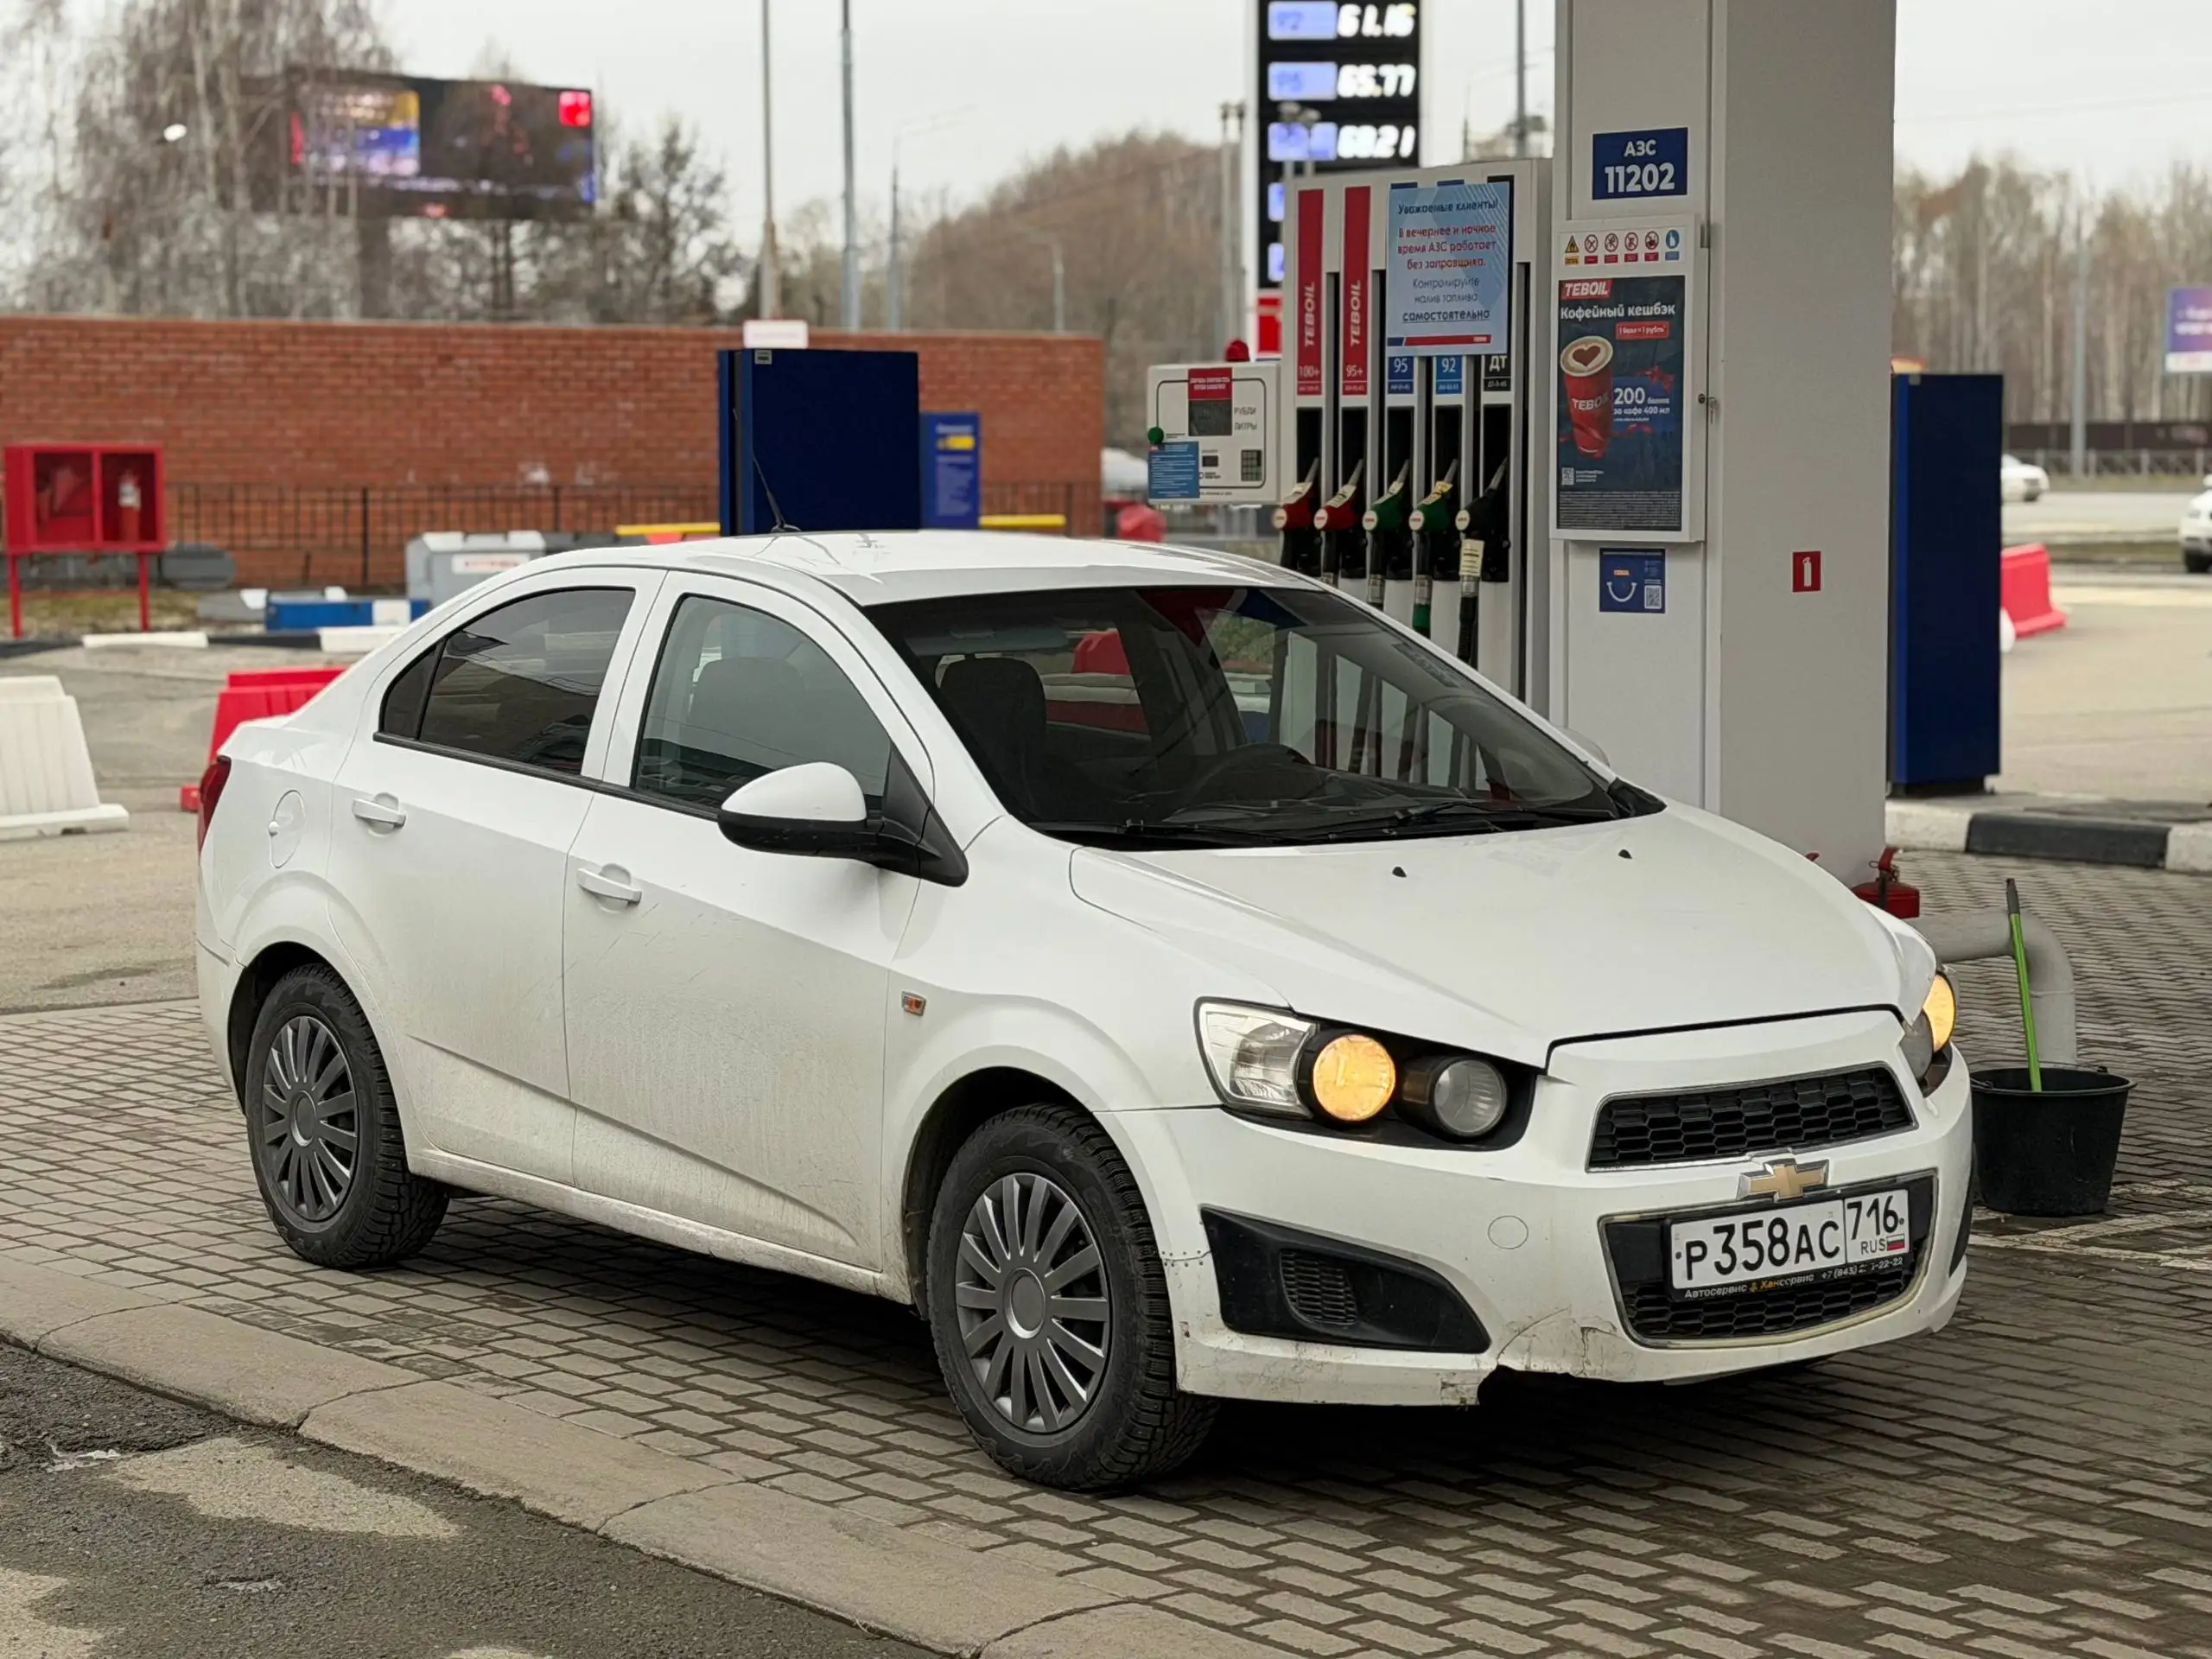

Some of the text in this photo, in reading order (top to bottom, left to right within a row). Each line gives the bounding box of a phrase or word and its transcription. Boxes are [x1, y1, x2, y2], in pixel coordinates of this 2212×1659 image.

[1624, 139, 1657, 157] АЗС
[1605, 162, 1675, 194] 11202
[1398, 198, 1498, 215] Уважаемые клиенты!
[1398, 224, 1497, 239] В вечернее и ночное
[1397, 239, 1497, 257] время АЗС работает
[1407, 258, 1423, 270] без
[1413, 276, 1480, 291] Контролируйте
[1564, 281, 1609, 297] TEBOIL
[1414, 293, 1478, 304] налив топлива
[1304, 281, 1316, 347] TEBOIL
[1350, 278, 1362, 346] TEBOIL
[1402, 308, 1491, 322] самостоятельно
[1560, 301, 1676, 322] Кофейный кешбэк
[1299, 364, 1321, 378] 100+
[1345, 363, 1364, 378] 95+
[1393, 357, 1409, 374] 95
[1440, 357, 1458, 373] 92
[1488, 354, 1508, 372] ДТ
[1613, 386, 1646, 405] 200
[1685, 1195, 1899, 1281] Р358АС 716
[1860, 1237, 1886, 1255] RUS
[1684, 1284, 1748, 1299] Автосервис
